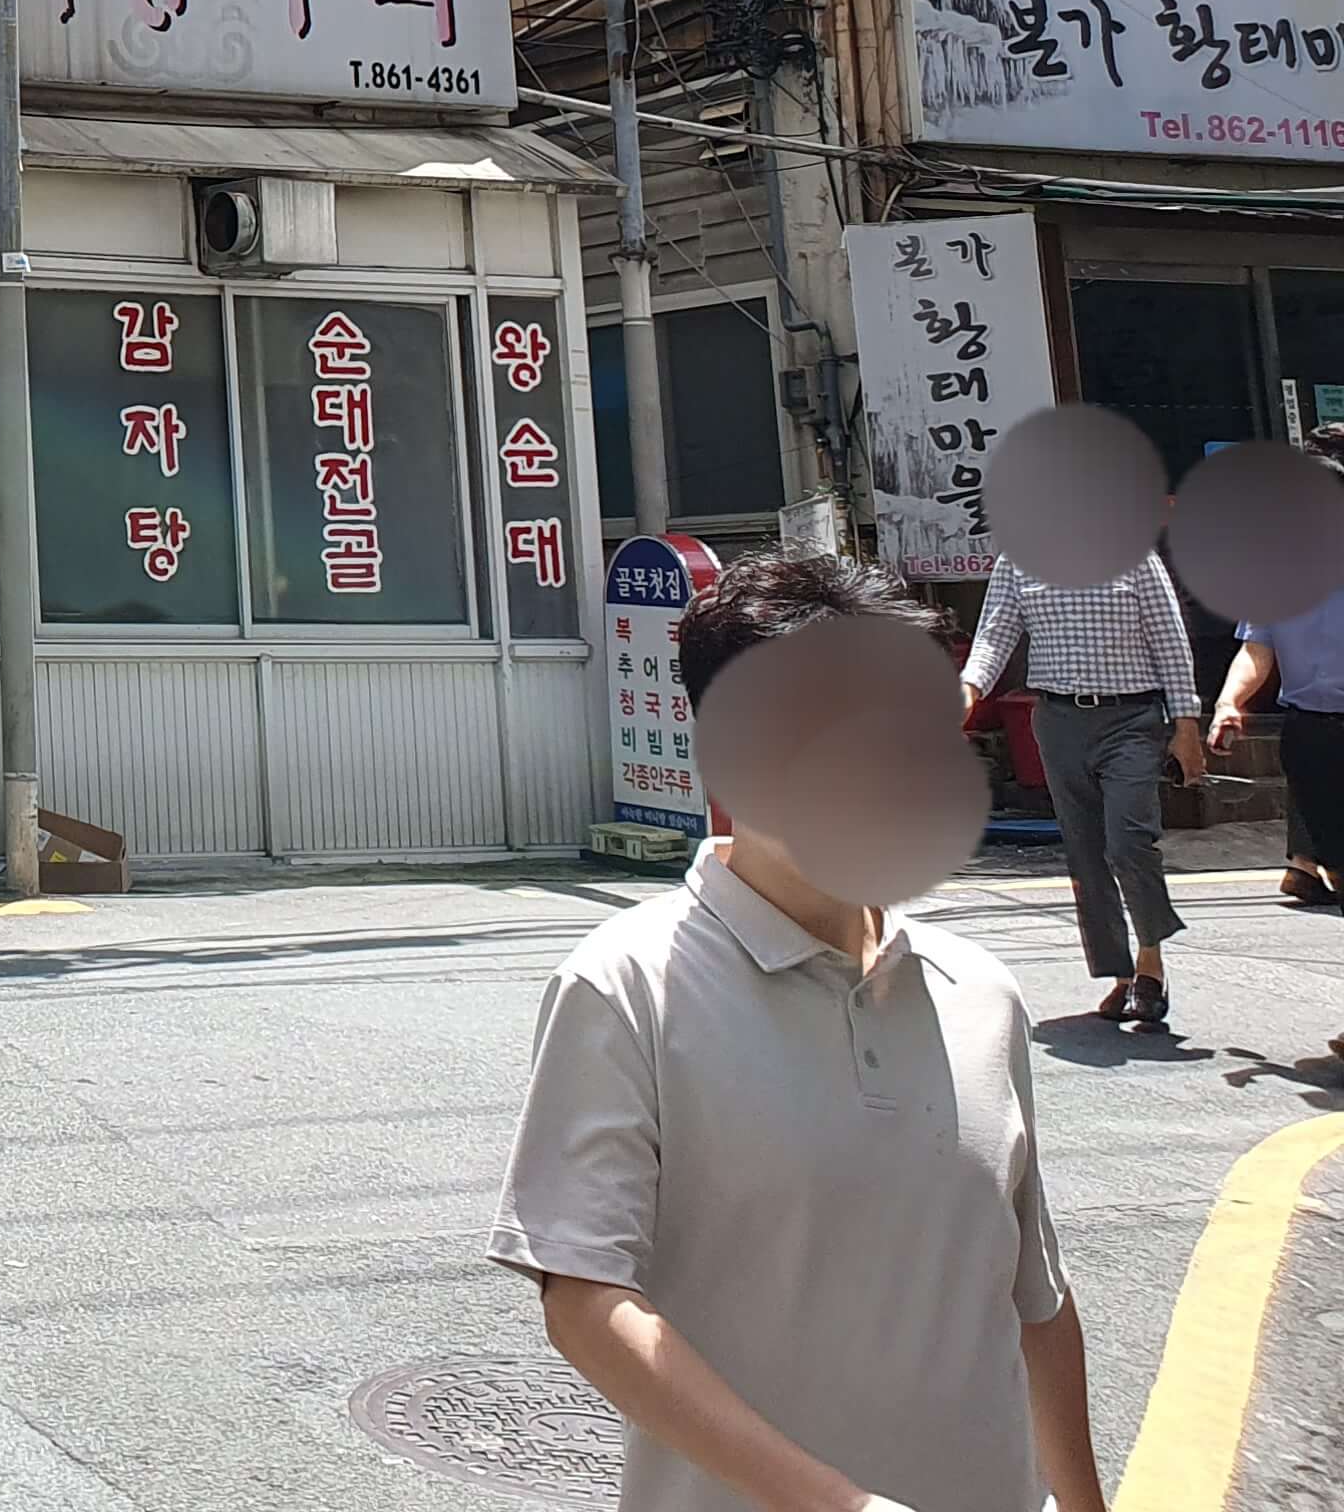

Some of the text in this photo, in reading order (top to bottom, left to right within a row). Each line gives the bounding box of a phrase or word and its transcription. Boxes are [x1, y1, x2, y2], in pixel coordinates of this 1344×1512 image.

[349, 60, 482, 96] T.861-4361
[114, 301, 191, 582] 감자탕
[309, 311, 382, 593] 순대전골
[493, 321, 566, 588] 왕순대
[616, 567, 682, 601] 골목첫집
[619, 689, 689, 723] 청국장
[621, 726, 690, 760] 비빔밥
